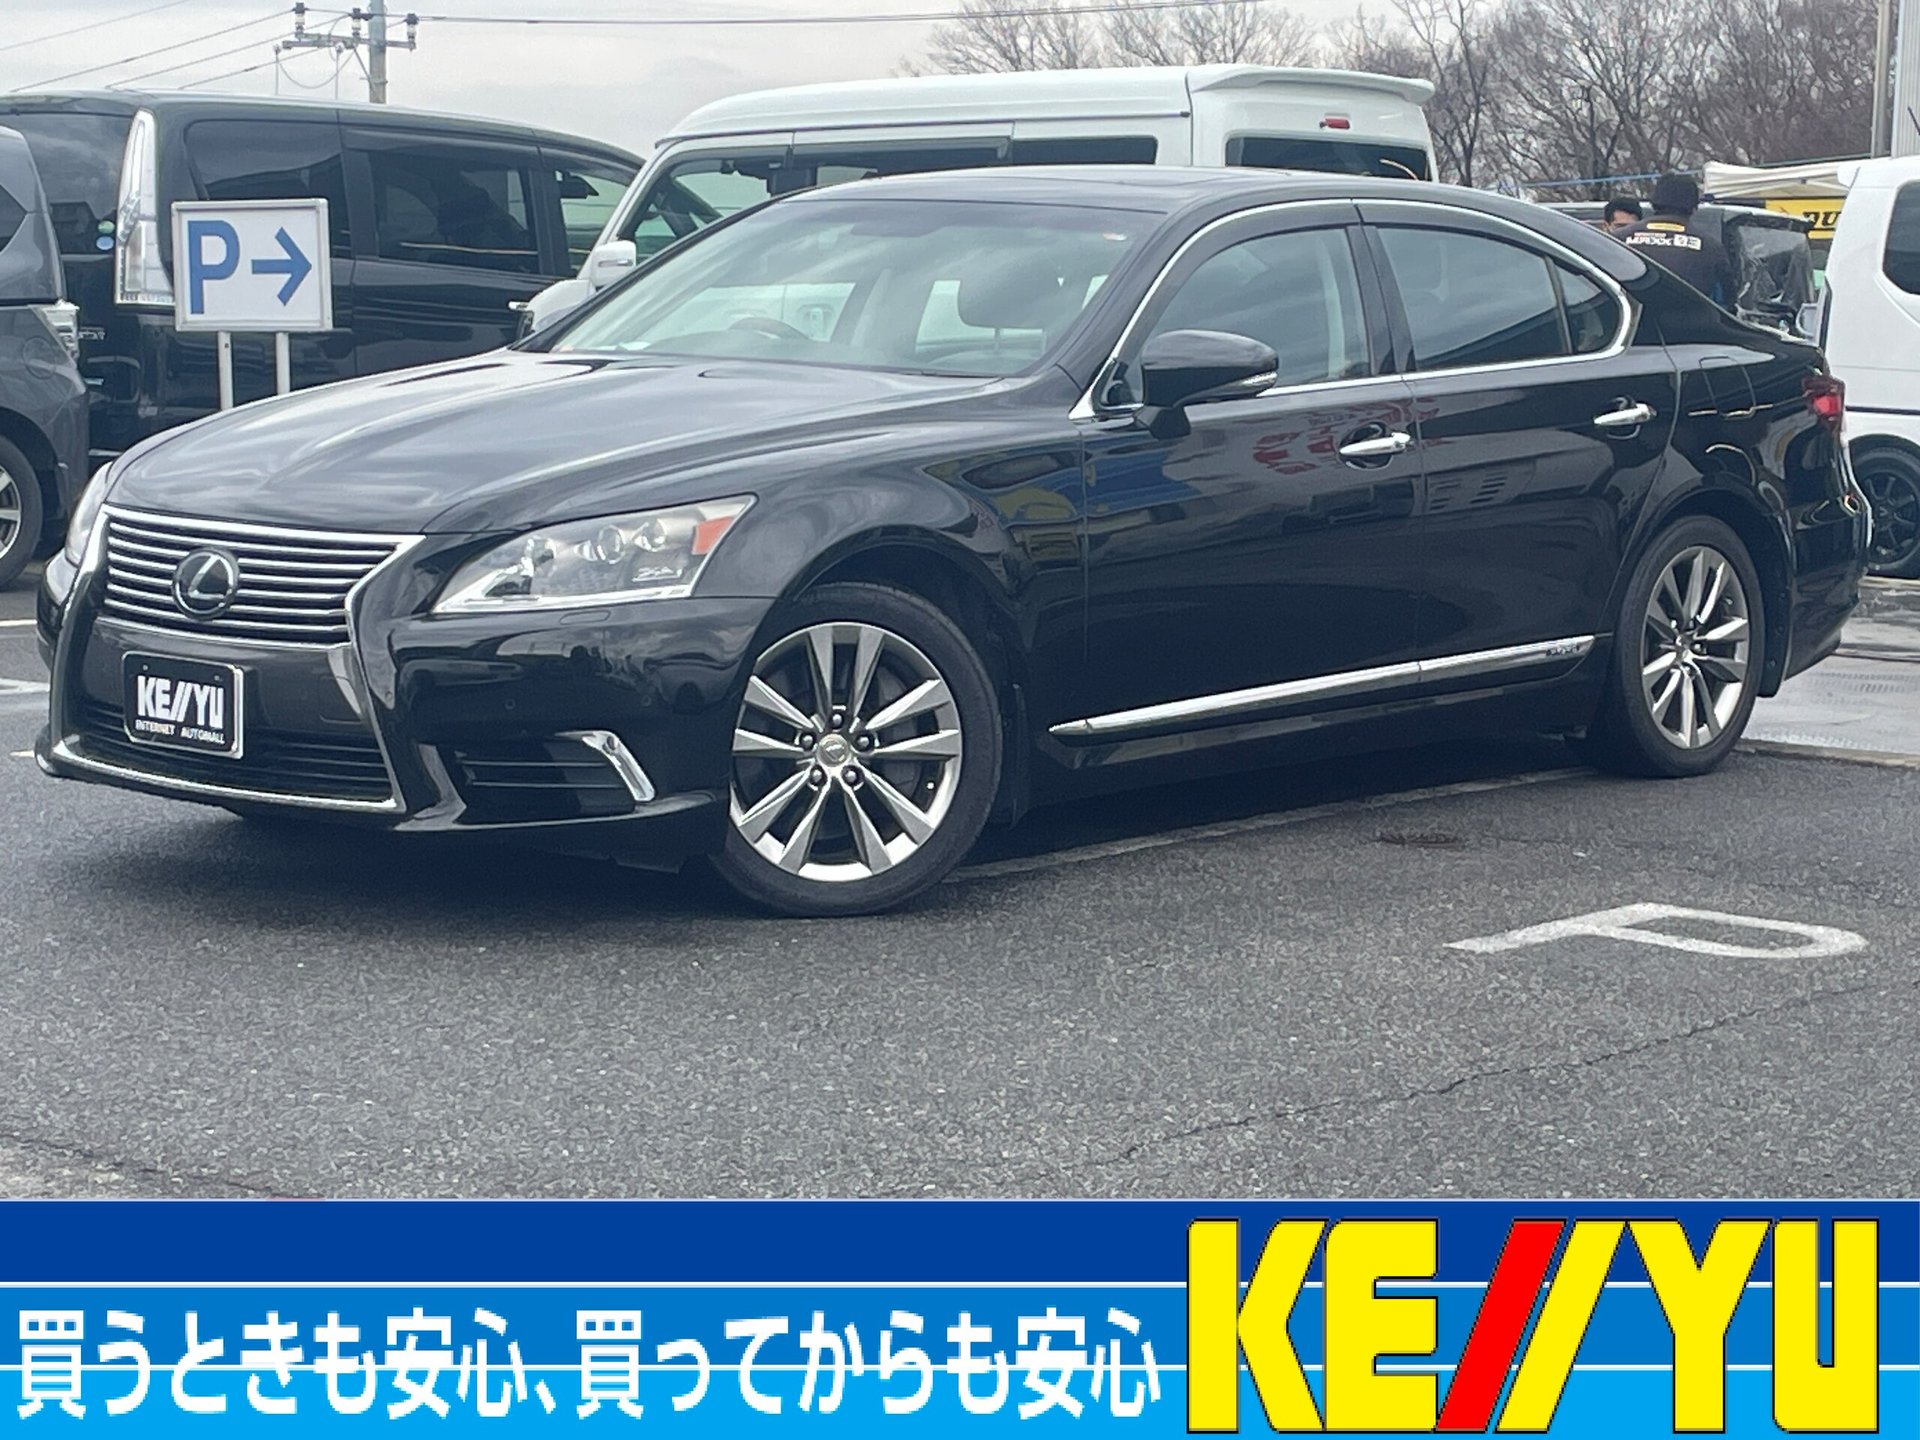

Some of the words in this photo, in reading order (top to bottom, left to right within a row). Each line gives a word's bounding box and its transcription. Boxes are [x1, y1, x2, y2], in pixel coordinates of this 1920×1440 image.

[187, 220, 240, 314] P
[135, 719, 175, 735] INTERNET
[181, 727, 225, 744] AUTOMALL
[1442, 902, 1868, 959] P
